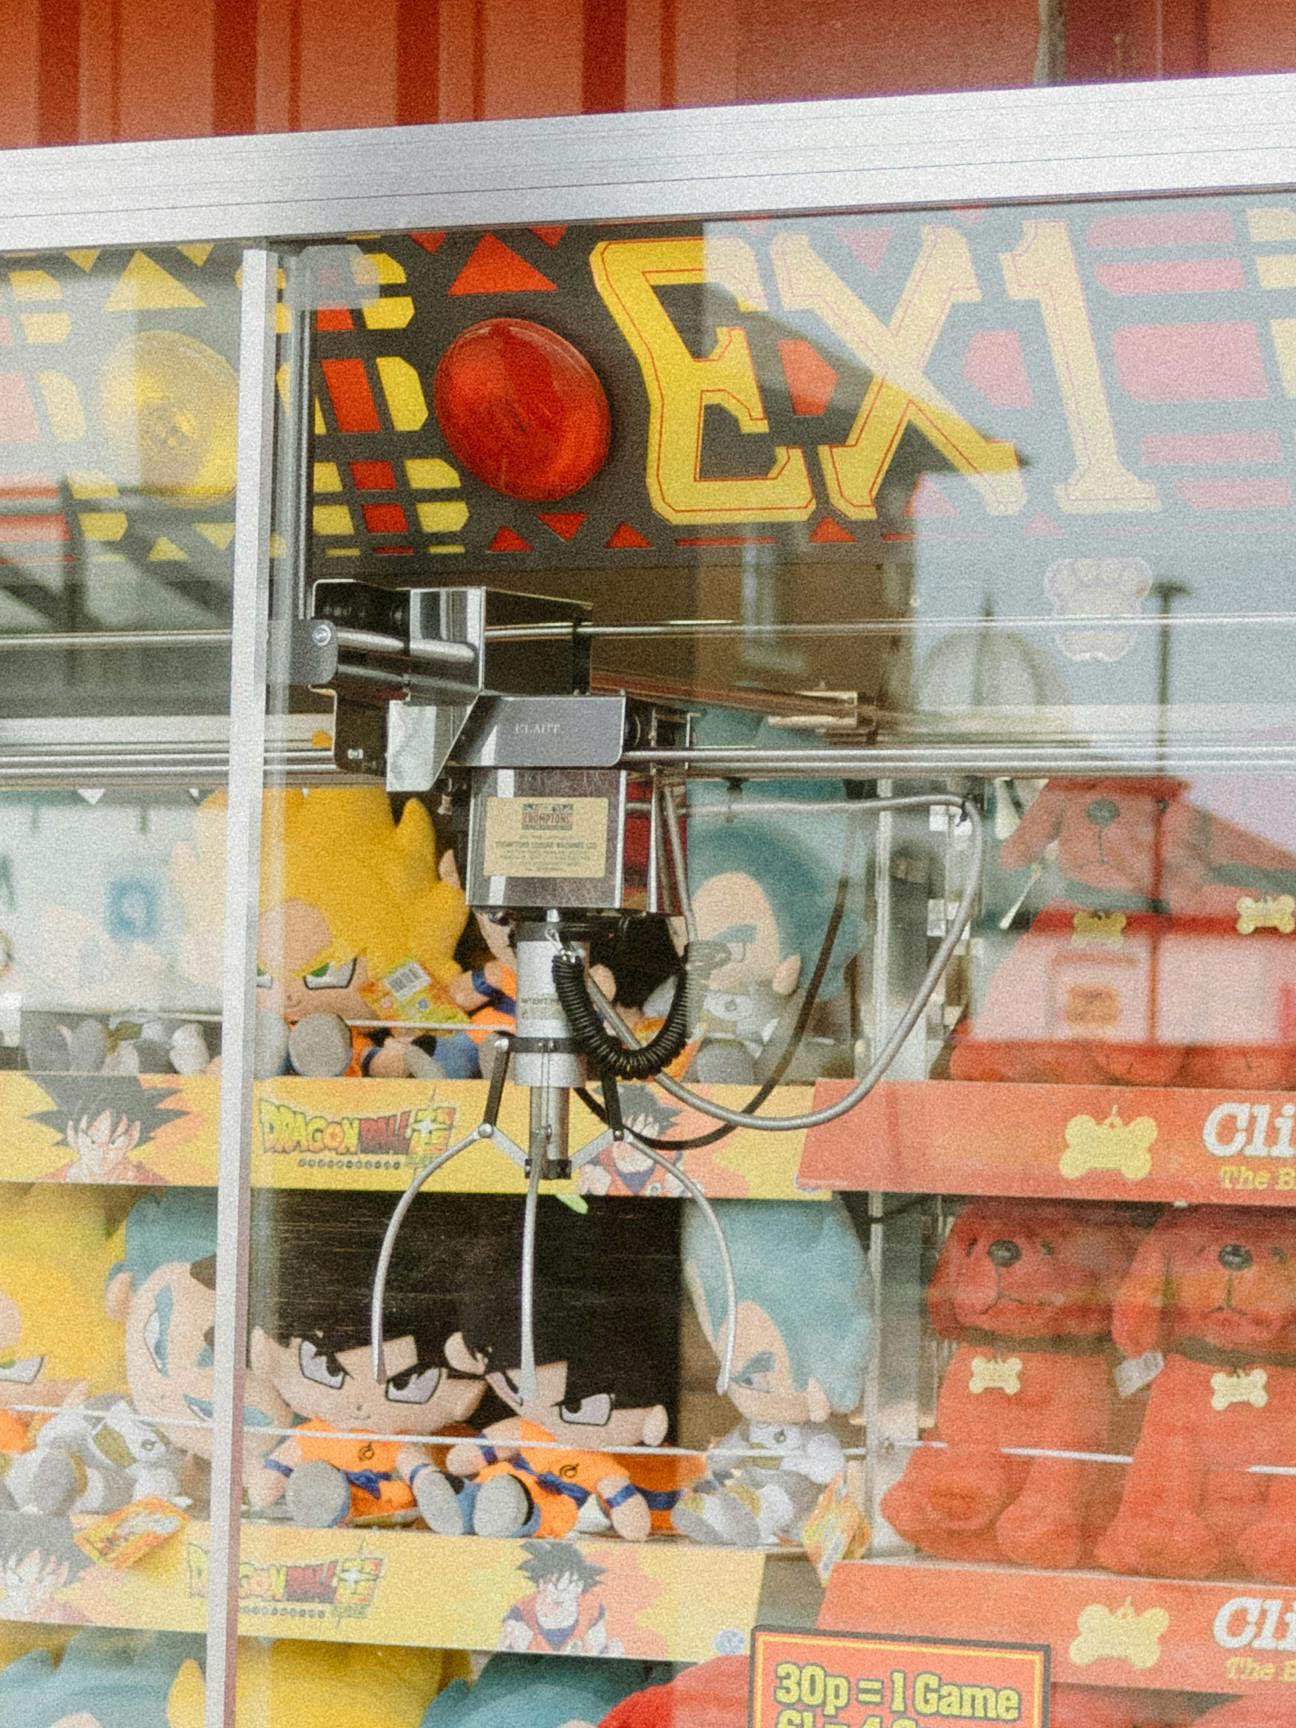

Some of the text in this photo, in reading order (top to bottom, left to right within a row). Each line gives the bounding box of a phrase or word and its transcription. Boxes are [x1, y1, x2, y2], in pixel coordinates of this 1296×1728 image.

[1220, 1165, 1269, 1189] The
[1226, 1656, 1276, 1680] The
[774, 1662, 1021, 1722] 30p = 1 Game
